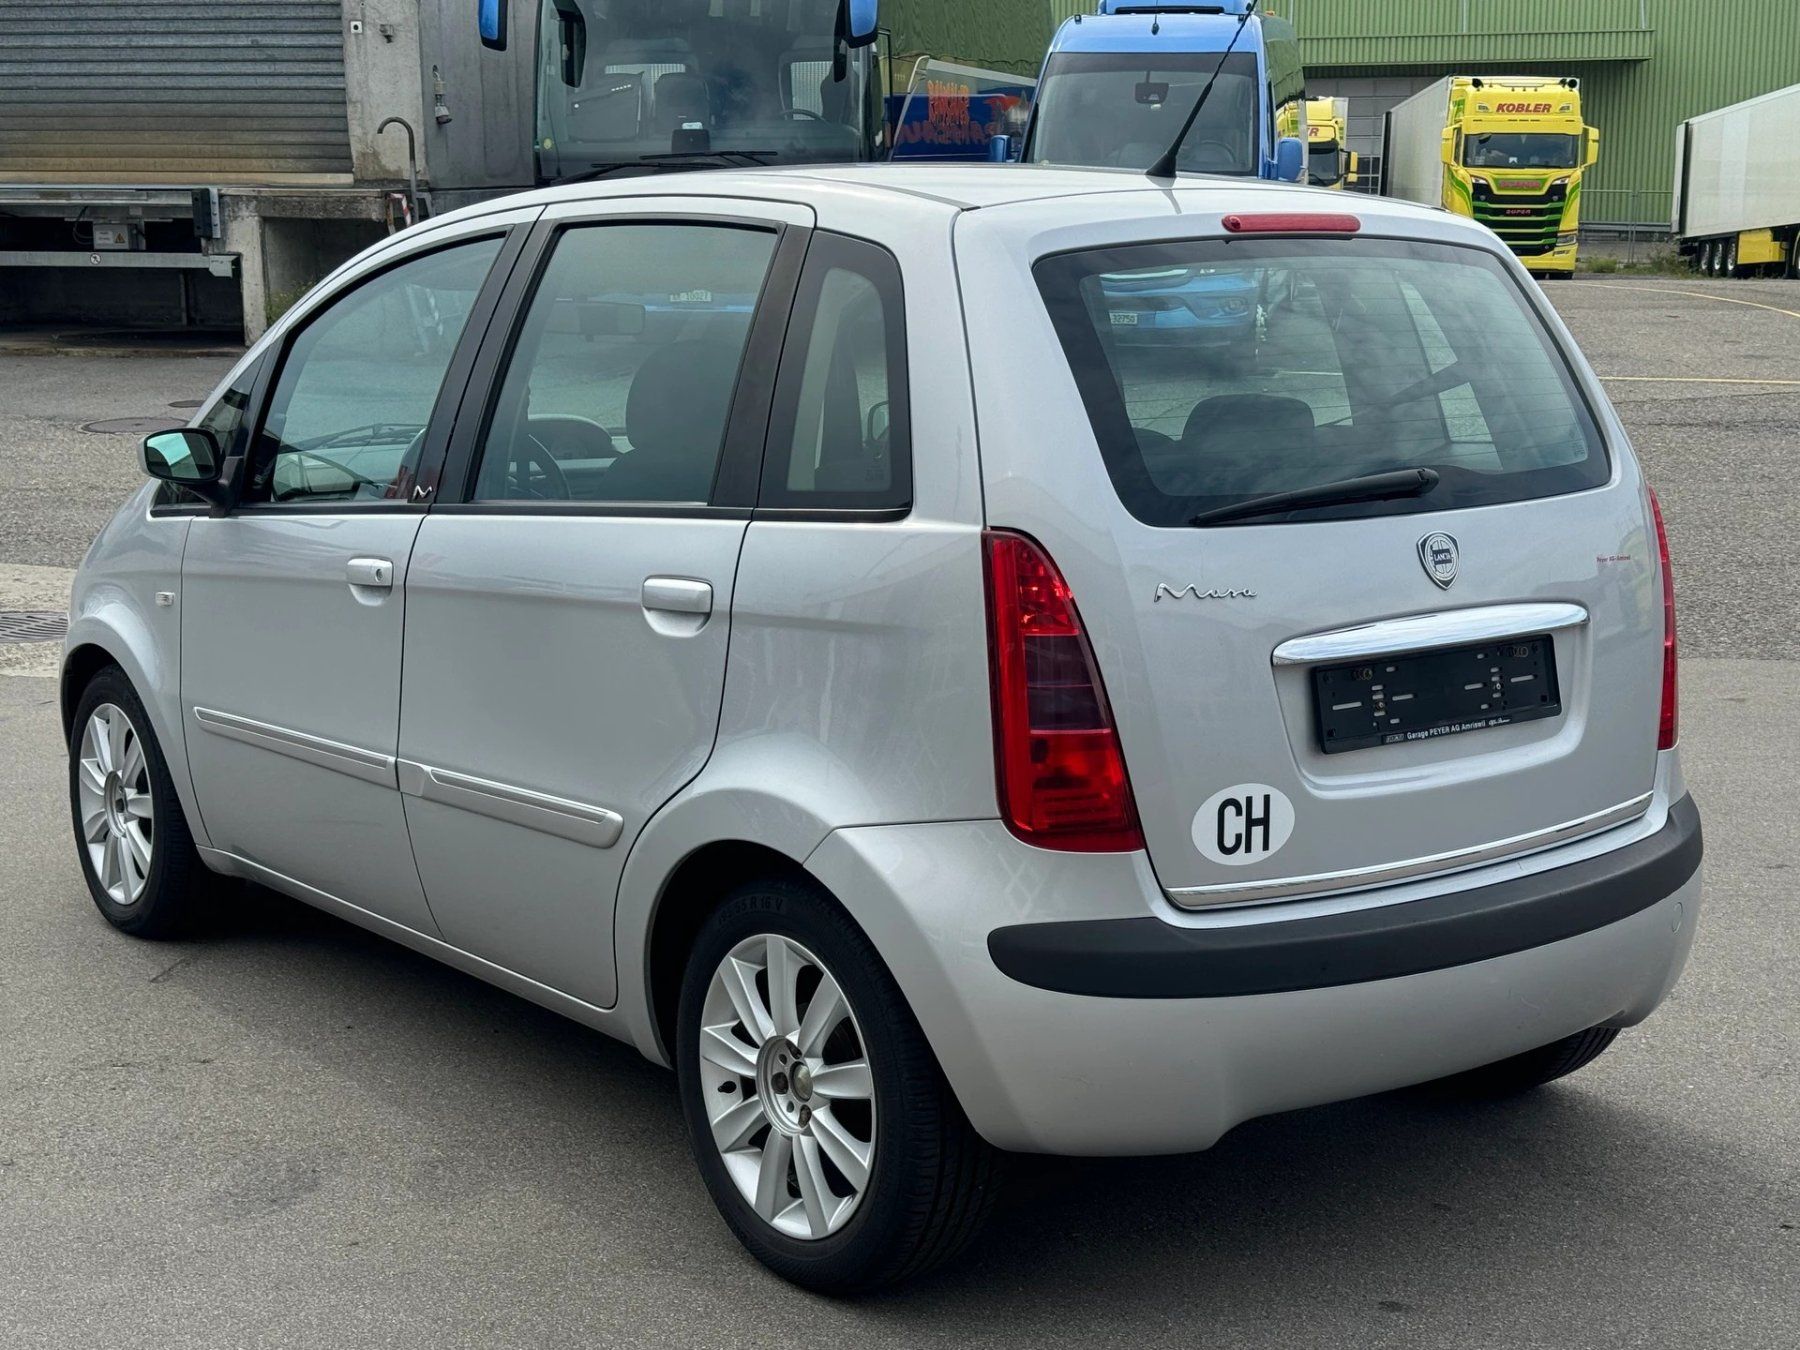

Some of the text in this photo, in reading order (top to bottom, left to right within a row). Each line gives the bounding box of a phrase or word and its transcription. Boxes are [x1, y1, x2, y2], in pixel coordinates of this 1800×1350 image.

[1496, 103, 1552, 113] KOBLER
[1407, 730, 1429, 741] Garage
[1429, 725, 1450, 736] PEYER
[1451, 724, 1460, 733] AG
[1461, 720, 1486, 731] Amriswil
[1217, 794, 1271, 856] CH
[750, 896, 757, 909] R
[760, 896, 771, 909] 16
